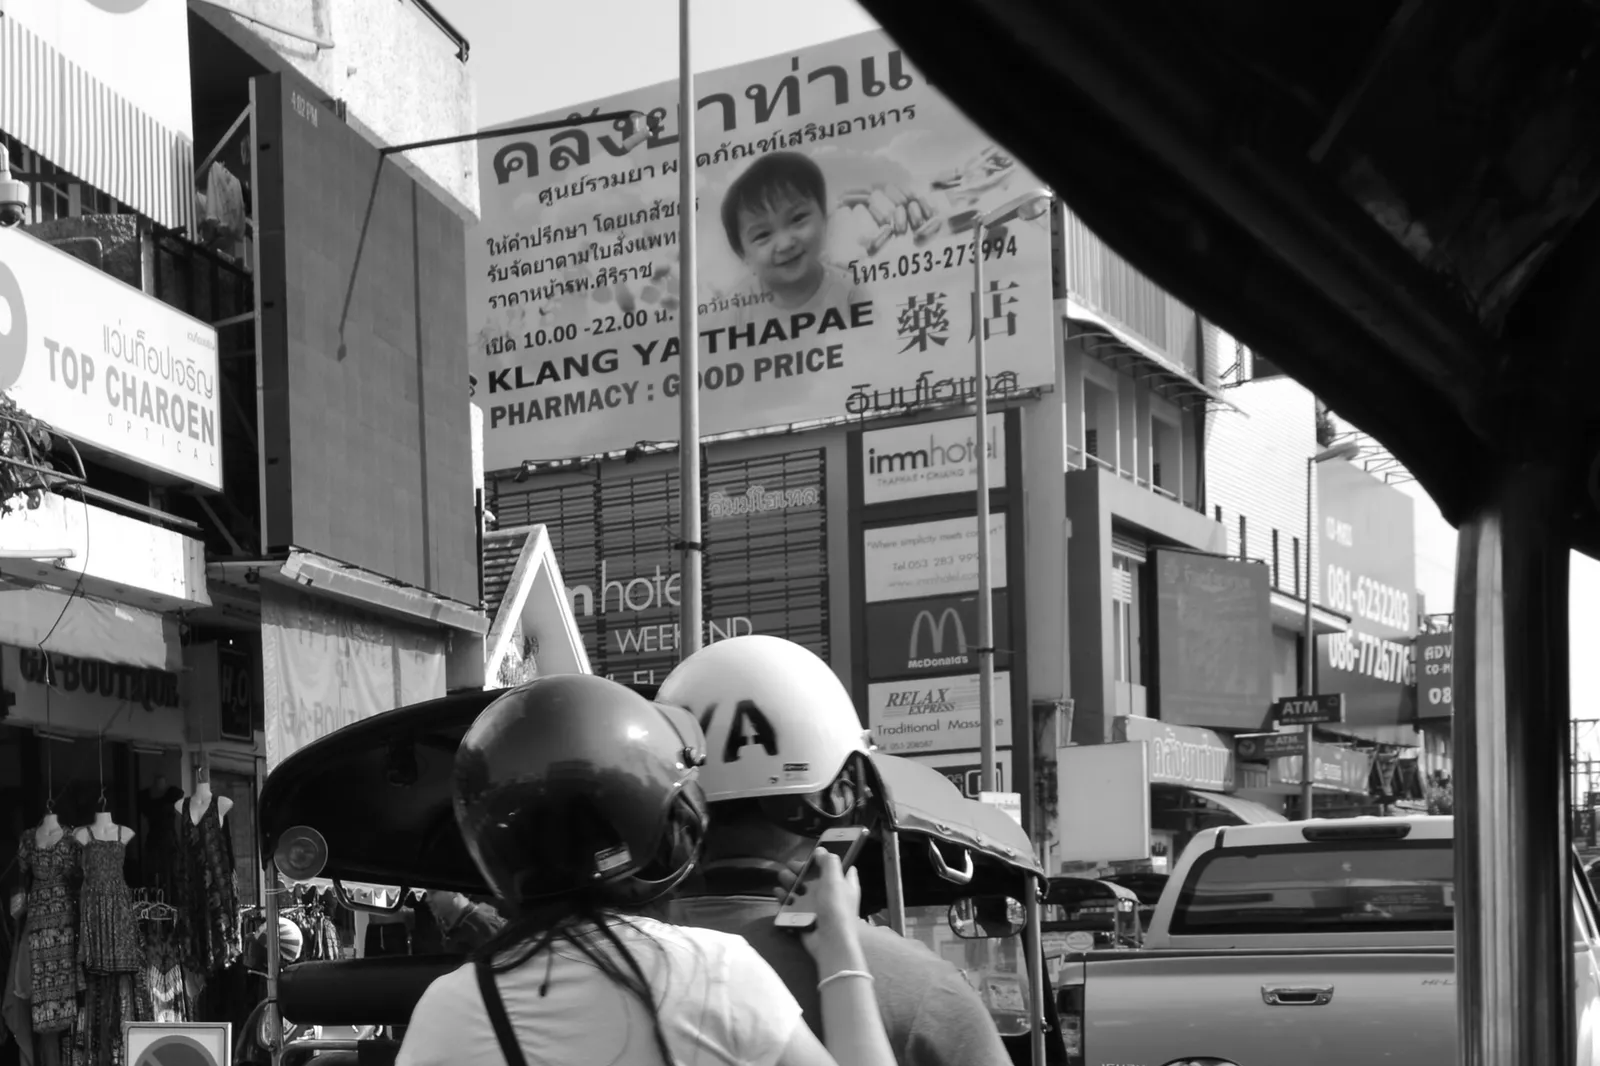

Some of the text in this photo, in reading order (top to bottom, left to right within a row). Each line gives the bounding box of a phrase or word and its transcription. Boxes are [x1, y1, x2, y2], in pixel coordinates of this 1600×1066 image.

[538, 103, 917, 207] ศูนย์รวมยา ผตภัณฑ์เสริมอาหาร
[103, 318, 214, 400] แว่นท็อปเจริญ
[485, 335, 517, 357] เปิด
[524, 323, 578, 350] 10.00
[584, 309, 648, 337] -22.00
[655, 307, 674, 324] น.
[488, 300, 874, 394] KLANG YA THAPAE
[44, 336, 216, 448] TOP CHAROEN
[490, 380, 640, 430] PHARMACY
[662, 362, 745, 398] GOD
[754, 343, 844, 382] PRICE
[1327, 563, 1410, 632] 081-6232203
[907, 655, 969, 669] McDonald's
[886, 687, 950, 709] RELAX
[908, 701, 957, 716] EXPRESS
[1281, 700, 1319, 716] ATM
[877, 719, 941, 737] Traditional
